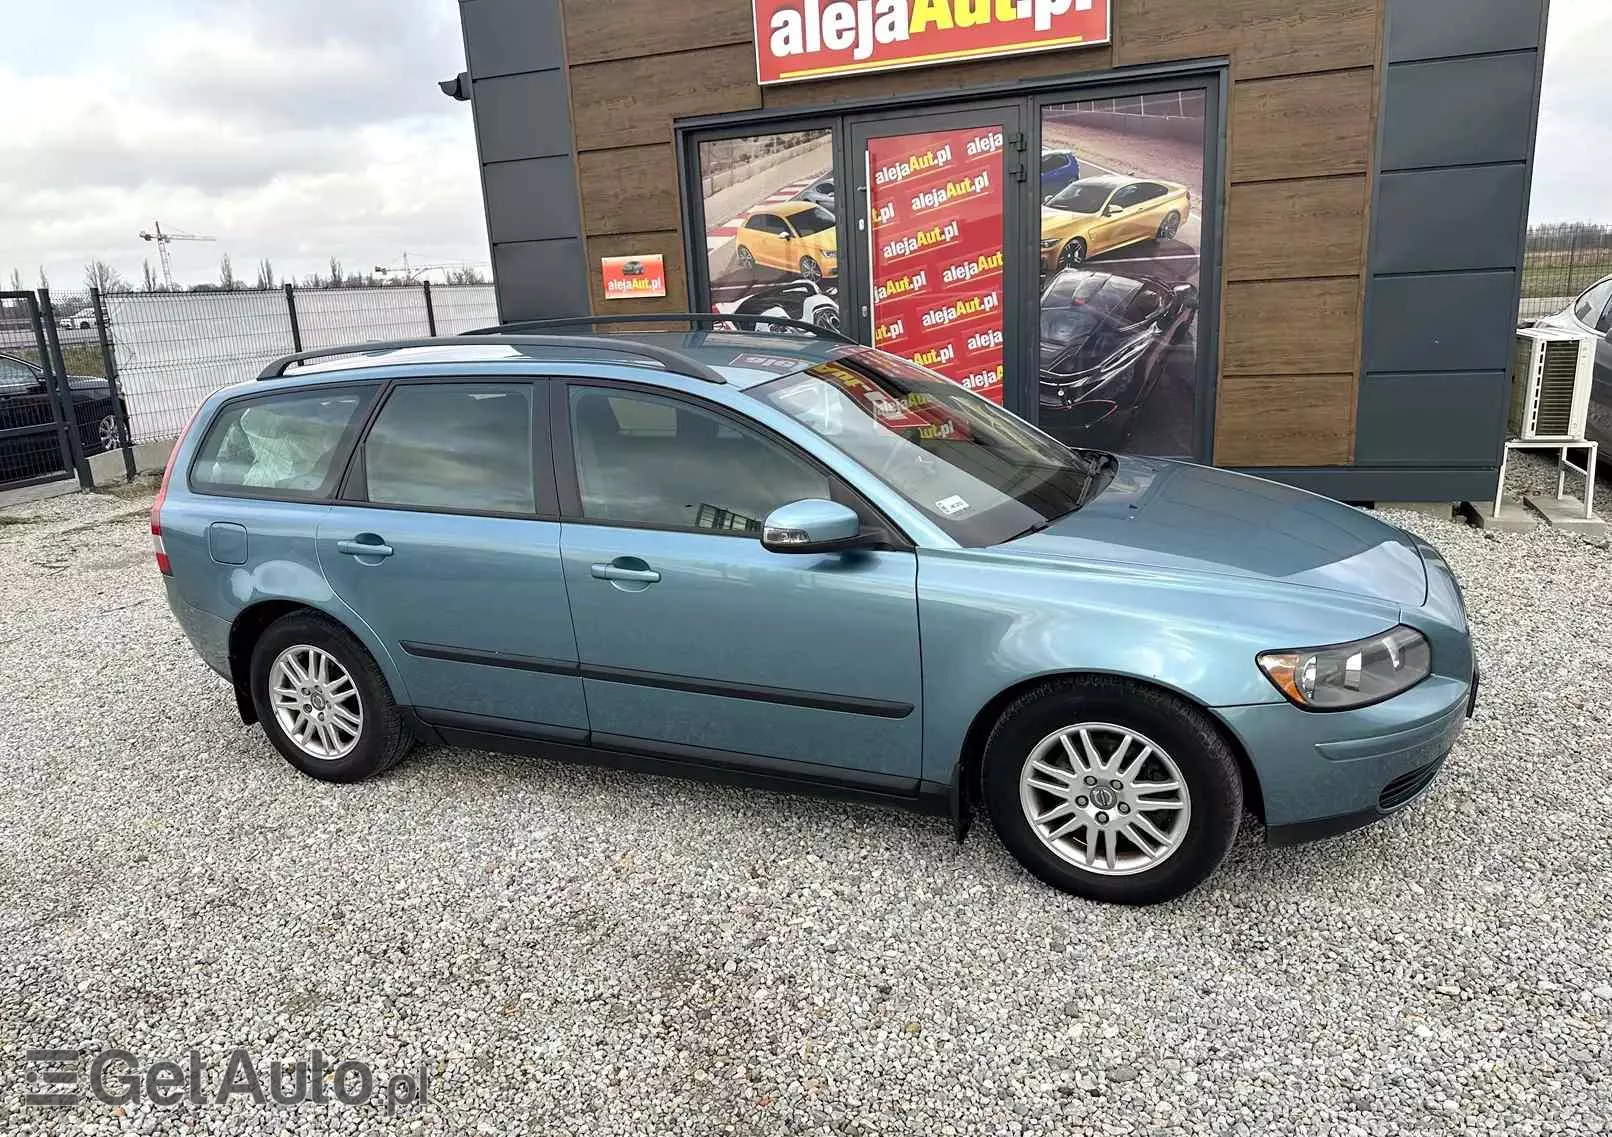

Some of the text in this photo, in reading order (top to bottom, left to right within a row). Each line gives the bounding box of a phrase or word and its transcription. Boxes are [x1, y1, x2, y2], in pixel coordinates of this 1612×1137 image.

[770, 0, 1092, 60] alejaAu.p
[875, 144, 952, 184] alejaAut.pl
[911, 170, 990, 211] alejaAut.pl
[883, 220, 959, 259] alejaAut.pl
[922, 292, 998, 326] alejaAut.pl
[909, 343, 954, 366] Aut.pl
